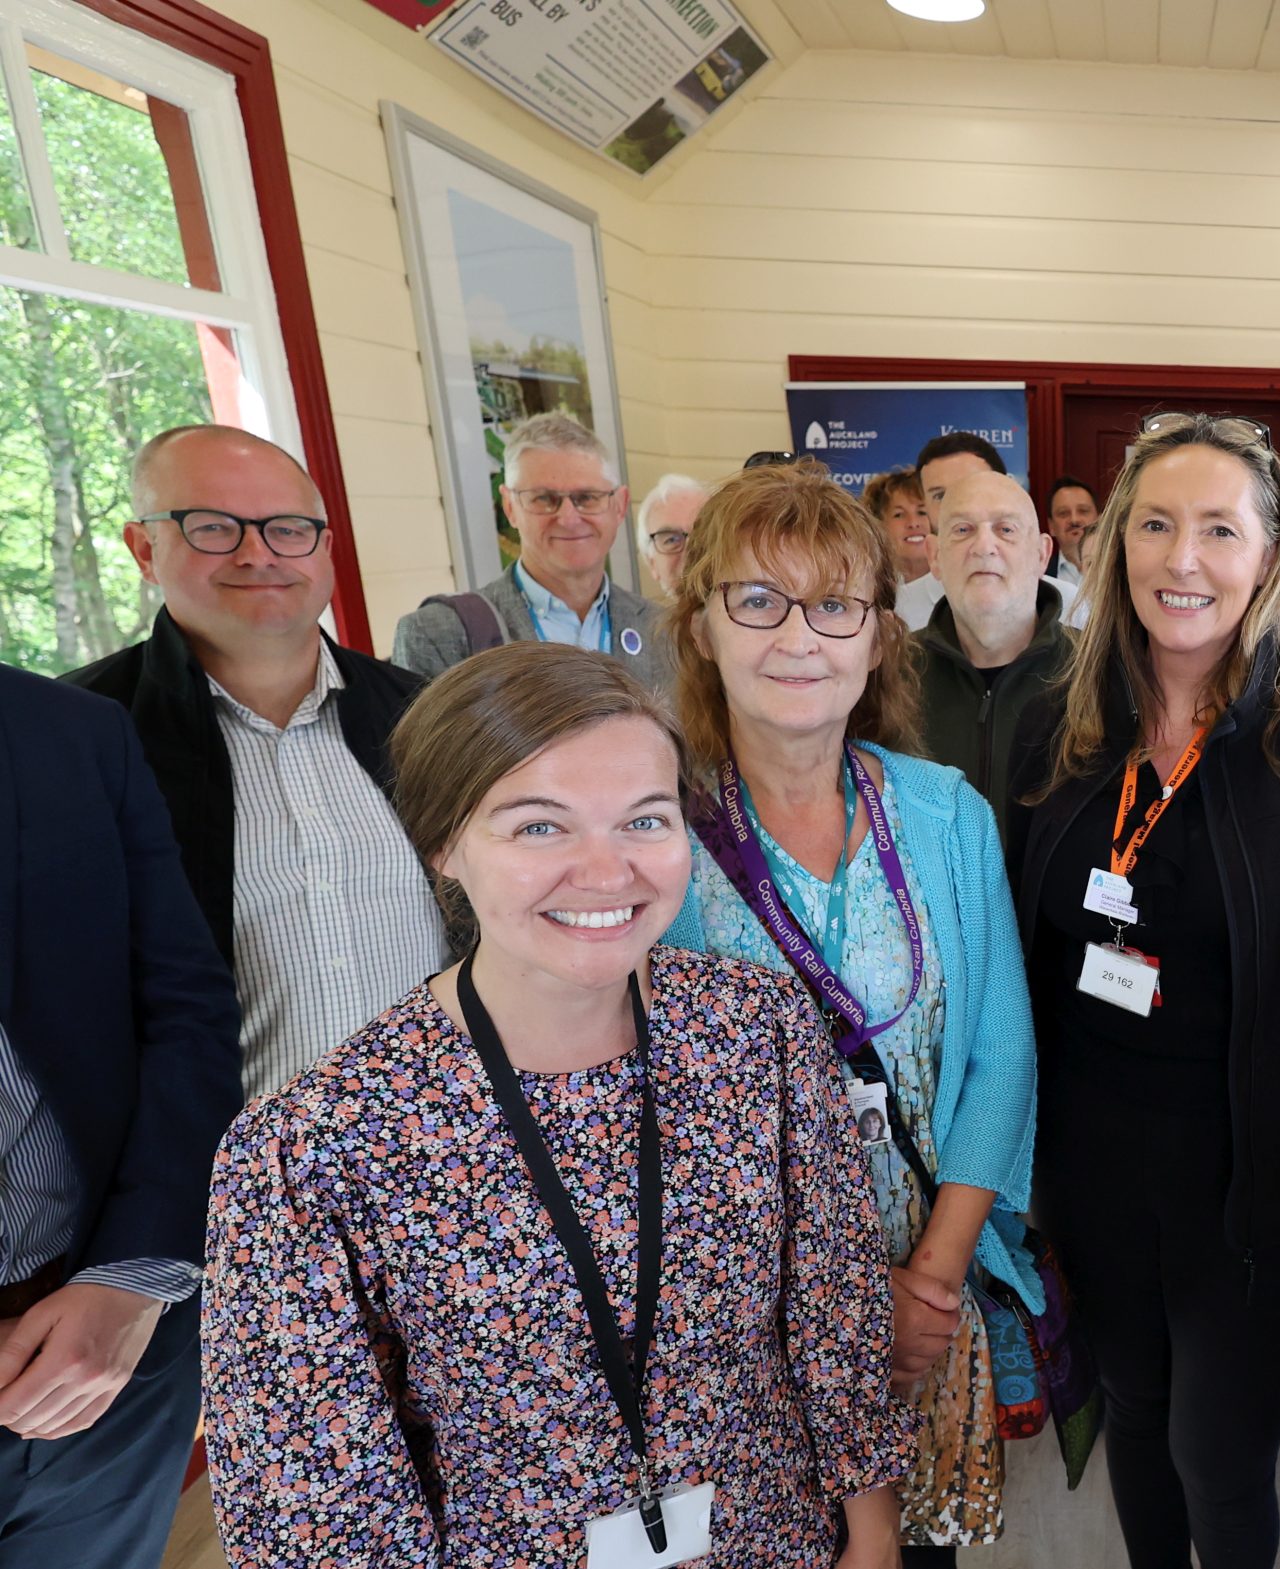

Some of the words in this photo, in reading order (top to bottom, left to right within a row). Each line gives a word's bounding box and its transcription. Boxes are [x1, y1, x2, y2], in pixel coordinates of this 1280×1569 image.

[489, 0, 523, 27] BUS
[545, 3, 570, 23] BY
[828, 421, 845, 430] THE
[829, 431, 879, 440] AUCKLAND
[829, 441, 869, 450] PROJECT
[721, 760, 737, 787] Rail
[1169, 751, 1196, 787] General
[725, 786, 749, 843] Cumbria
[863, 783, 891, 851] Community
[896, 888, 919, 940] Cumbria
[757, 879, 804, 952] Community
[799, 949, 825, 978] Rail
[821, 975, 865, 1026] Cumbria
[912, 944, 921, 969] Rail
[1102, 970, 1114, 981] 29
[1116, 976, 1134, 989] 162
